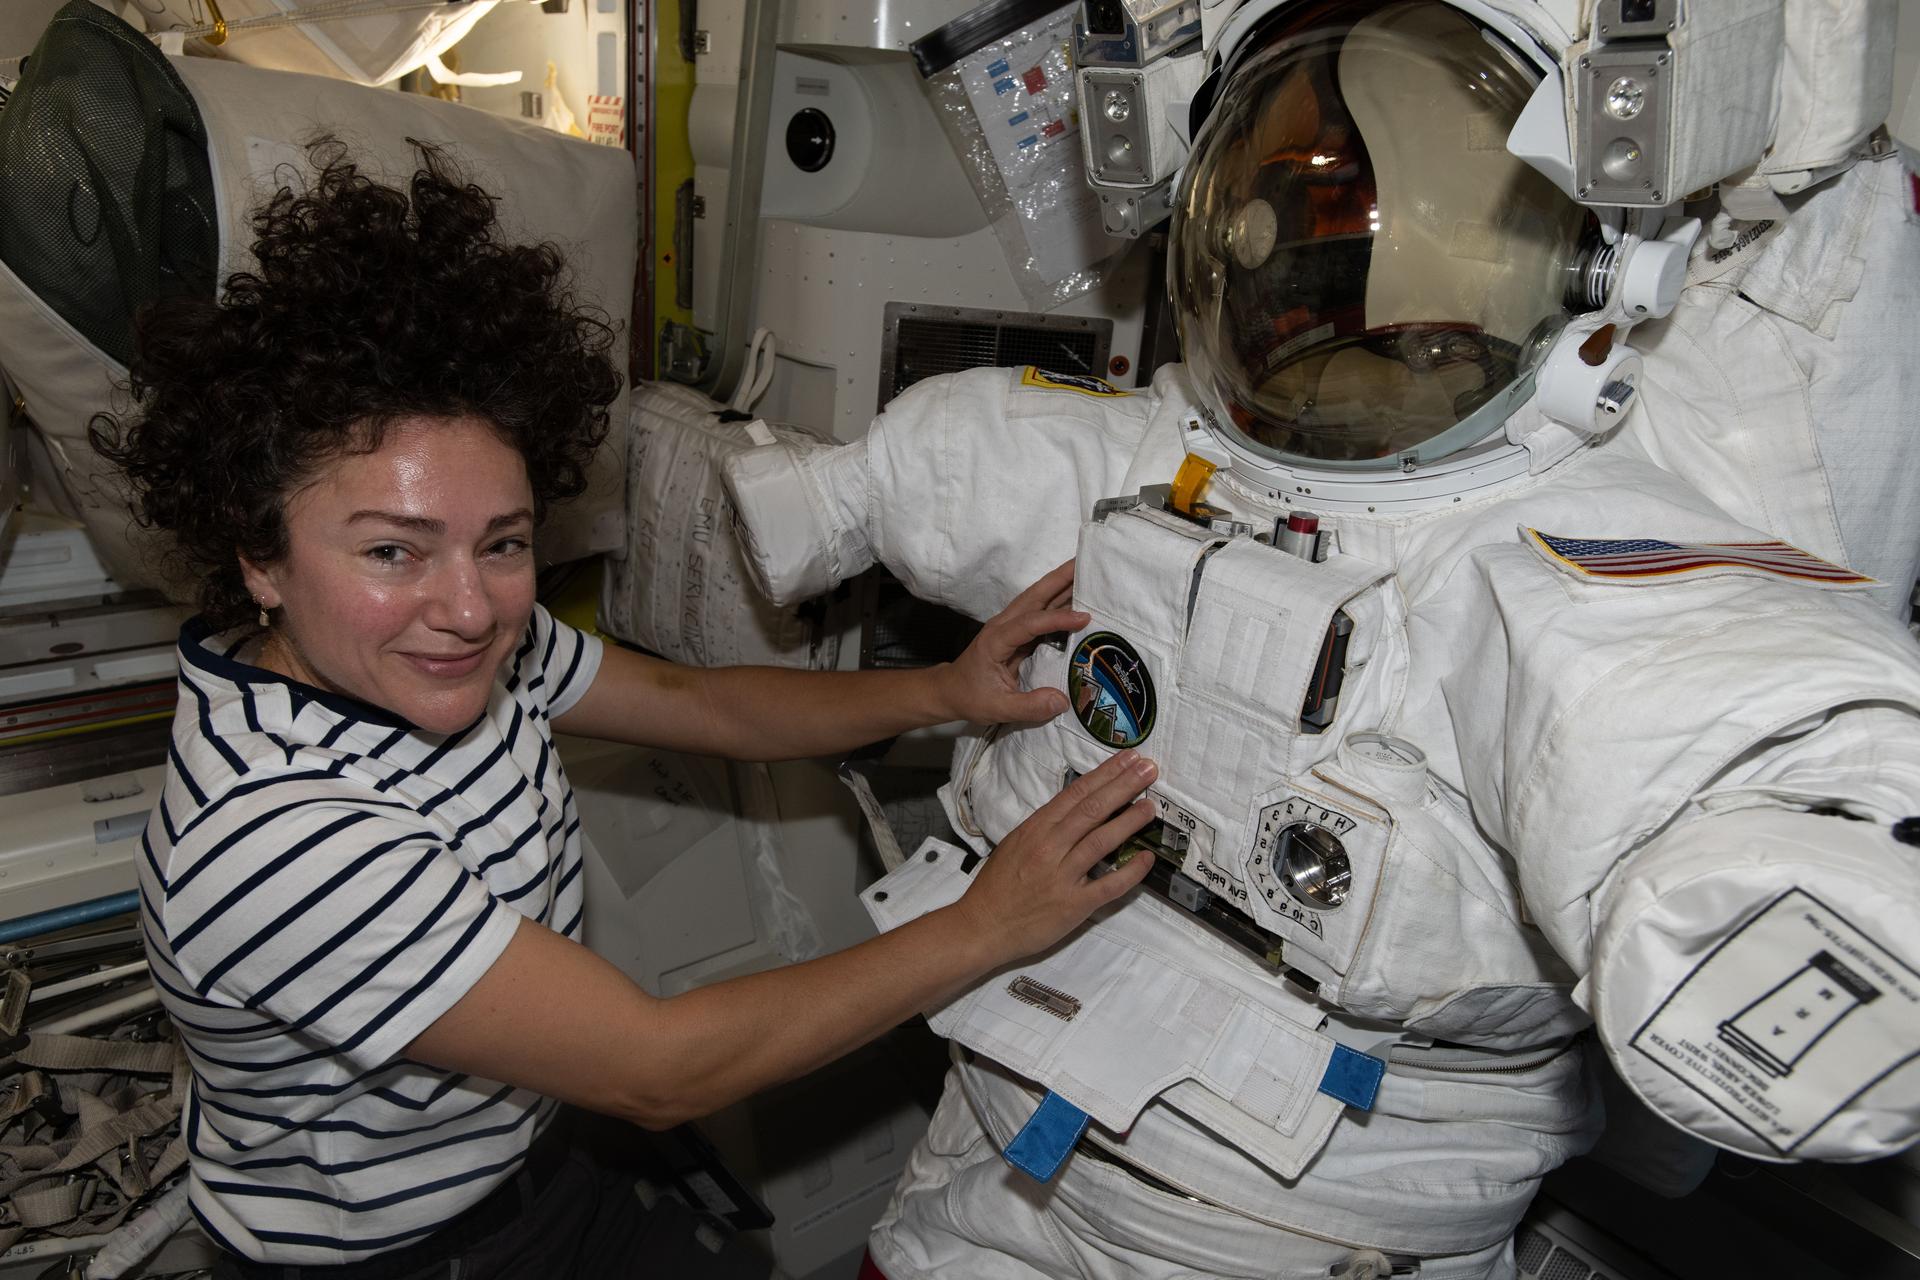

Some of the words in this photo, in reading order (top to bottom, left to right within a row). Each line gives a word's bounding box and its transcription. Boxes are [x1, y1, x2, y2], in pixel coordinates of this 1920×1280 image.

[640, 517, 654, 552] KIT
[691, 496, 714, 545] EMU
[1649, 1032, 1685, 1060] COVER
[1678, 1038, 1709, 1063] WRIST
[1684, 1055, 1748, 1105] PROTECTIVE
[1703, 1041, 1771, 1093] DISCONNECT
[1741, 1083, 1782, 1115] LOWER
